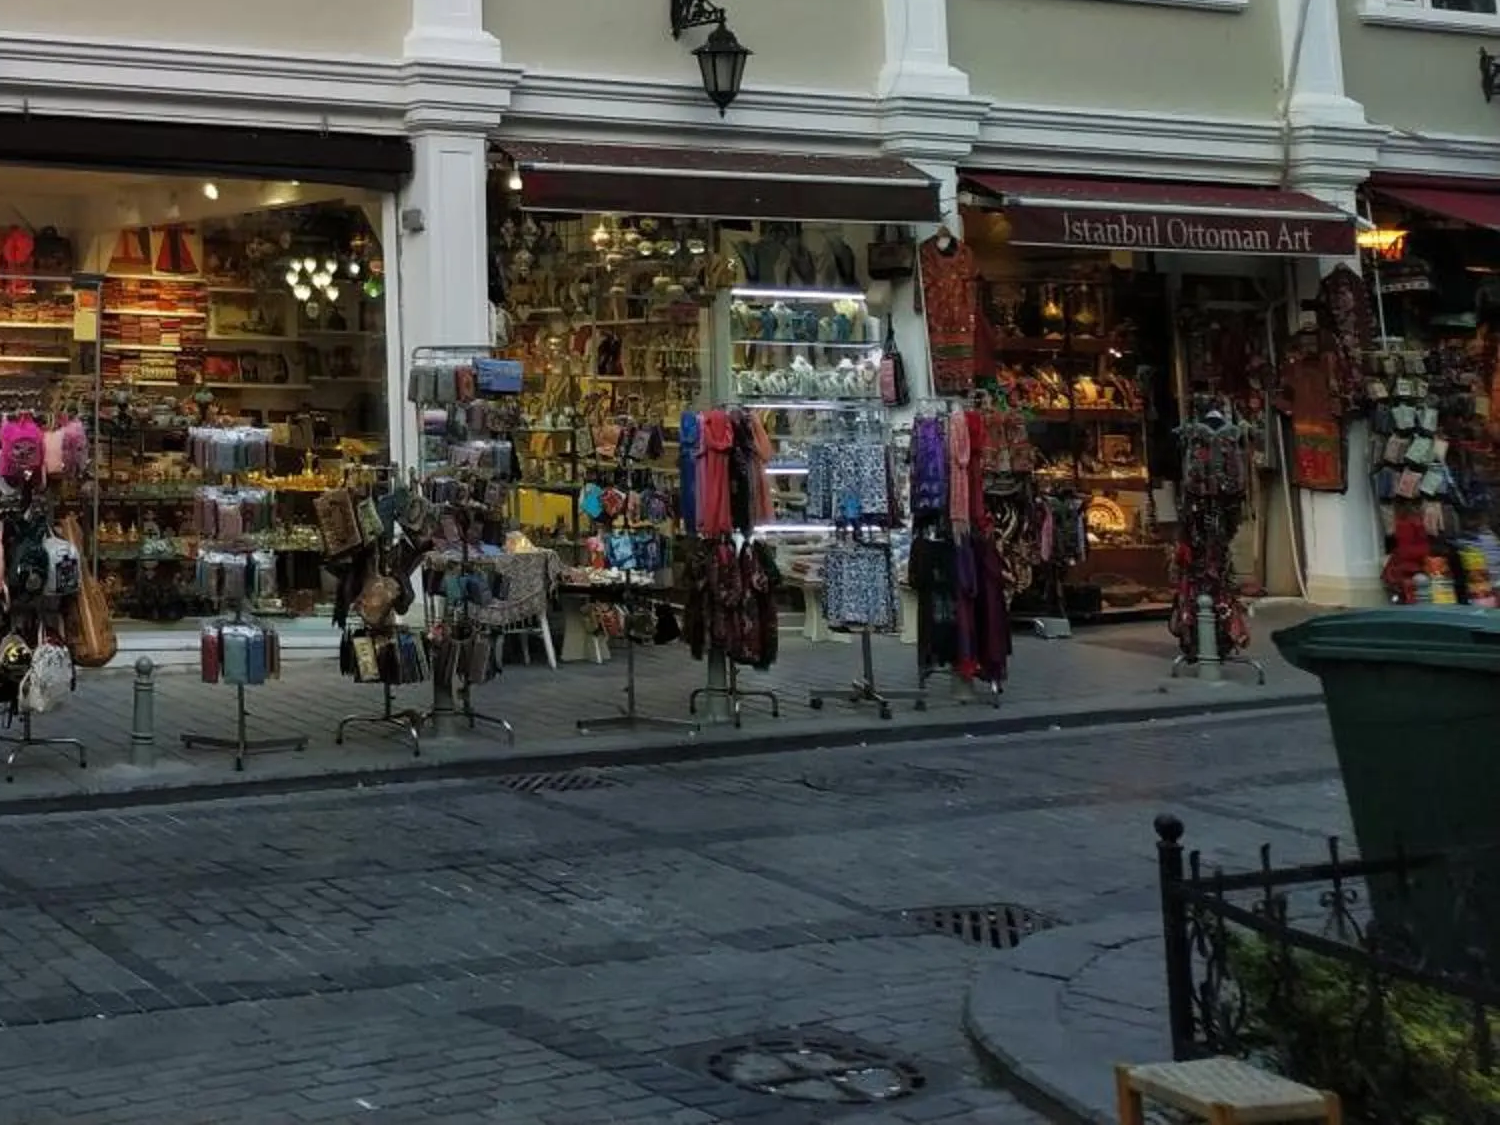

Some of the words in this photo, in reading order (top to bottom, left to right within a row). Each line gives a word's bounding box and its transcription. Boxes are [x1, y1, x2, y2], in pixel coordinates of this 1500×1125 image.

[1061, 212, 1159, 246] Istanbul
[1167, 218, 1270, 250] Ottoman
[1276, 223, 1313, 251] Art
